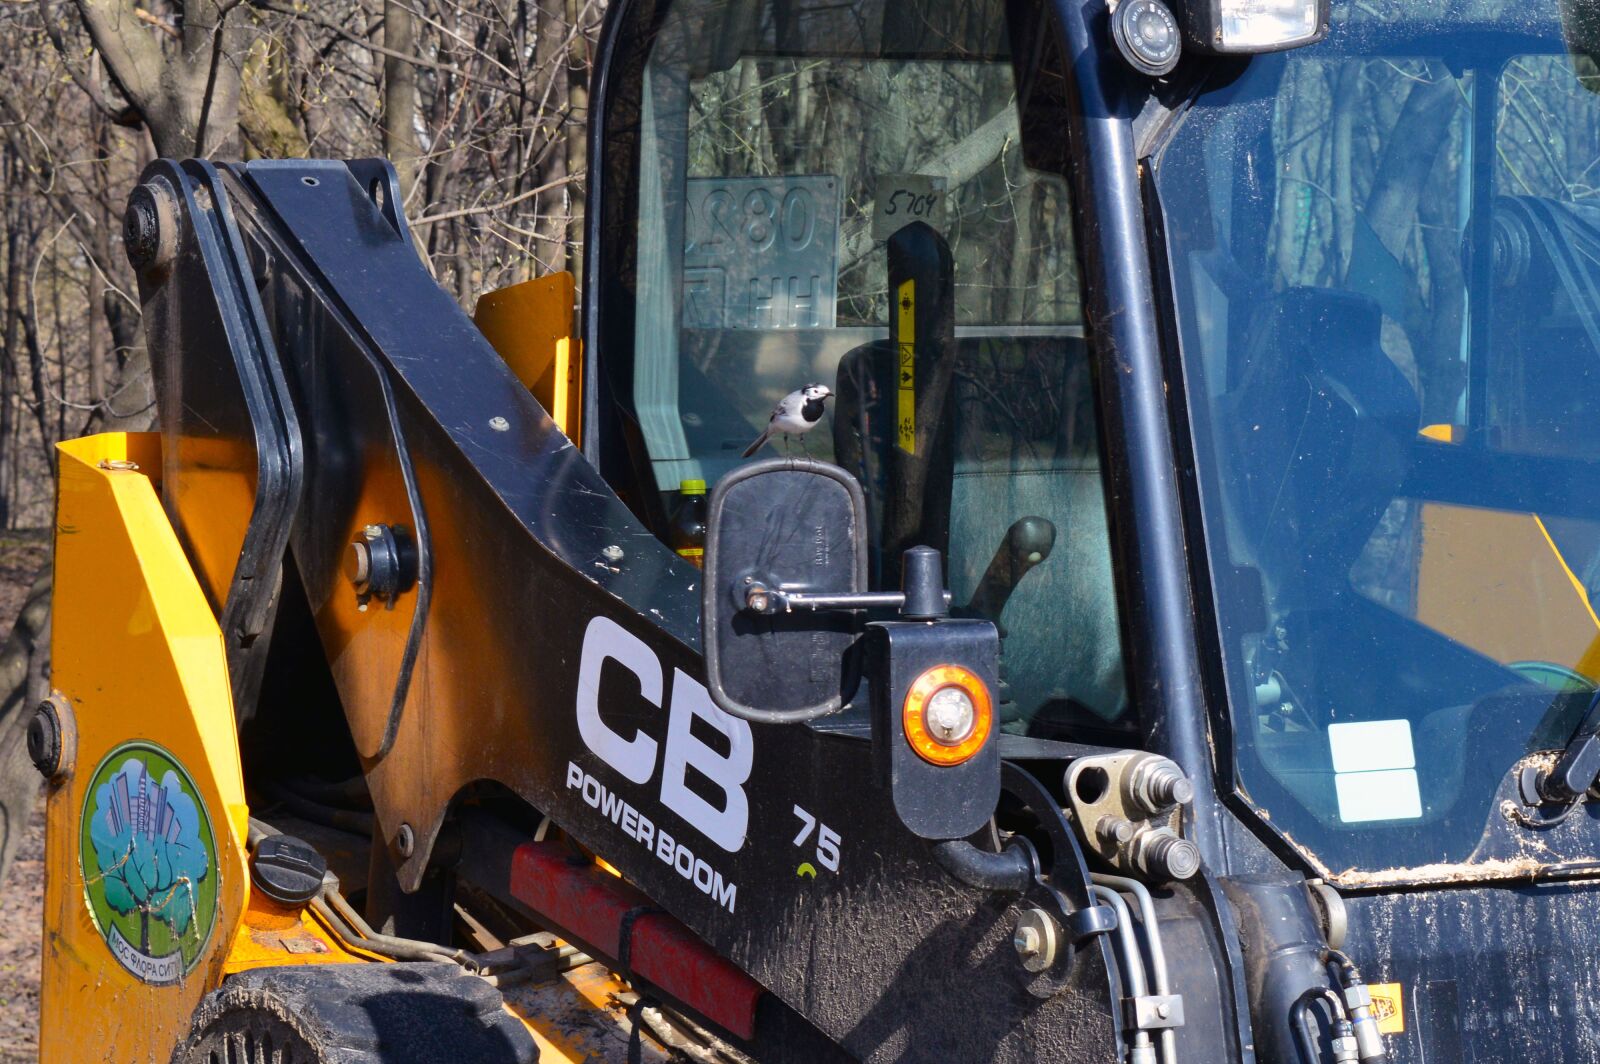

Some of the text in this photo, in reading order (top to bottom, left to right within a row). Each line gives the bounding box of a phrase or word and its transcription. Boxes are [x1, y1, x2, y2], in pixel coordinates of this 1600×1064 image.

[884, 189, 937, 218] 5704
[566, 761, 737, 913] POWER BOOM
[793, 804, 841, 872] 75
[111, 932, 129, 960] МОС
[131, 953, 157, 977] ФЛОРА
